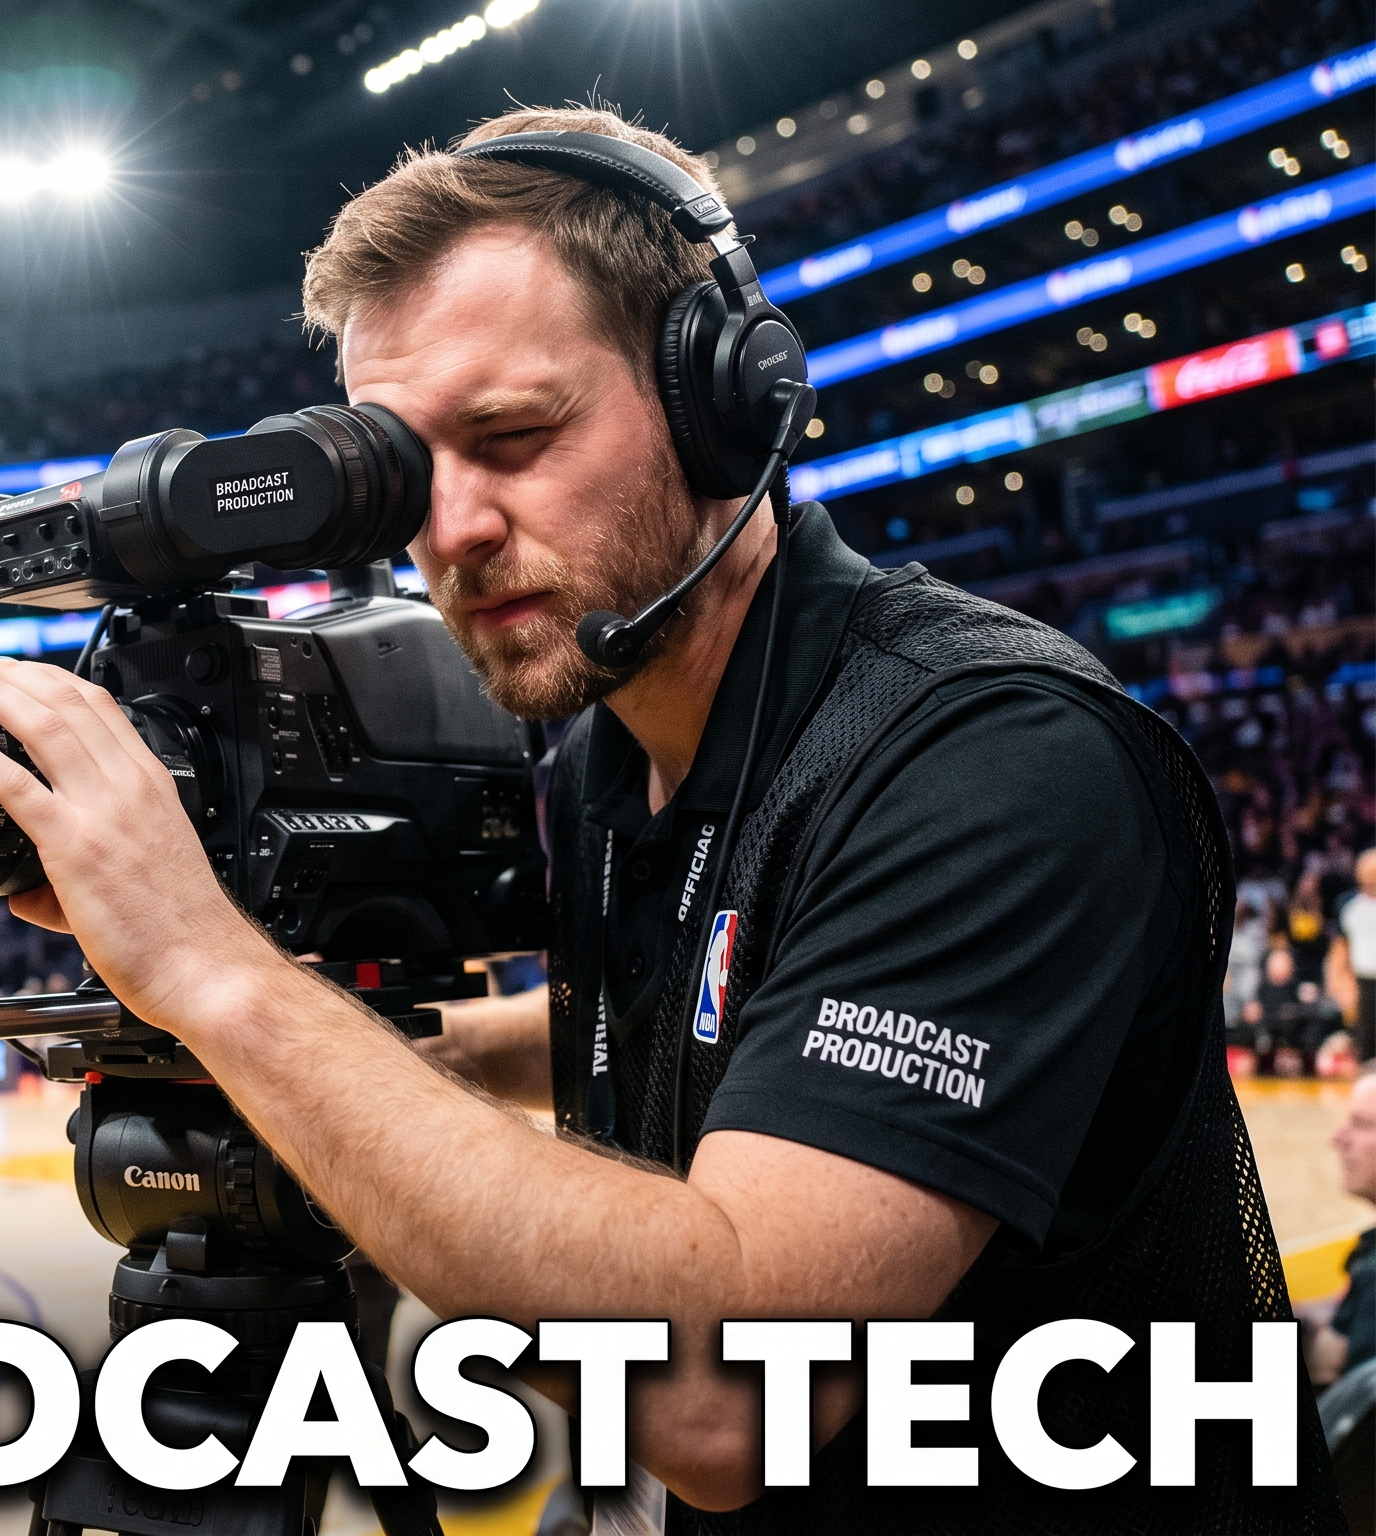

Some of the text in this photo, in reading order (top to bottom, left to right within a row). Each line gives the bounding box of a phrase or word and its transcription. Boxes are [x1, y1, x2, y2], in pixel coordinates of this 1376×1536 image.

[215, 471, 290, 496] BROADCAST
[216, 487, 295, 512] PRODUCTION
[698, 1011, 717, 1034] NBA
[817, 997, 991, 1070] BROADCAST
[801, 1029, 986, 1109] PRODUCTION
[124, 1165, 201, 1192] Canon
